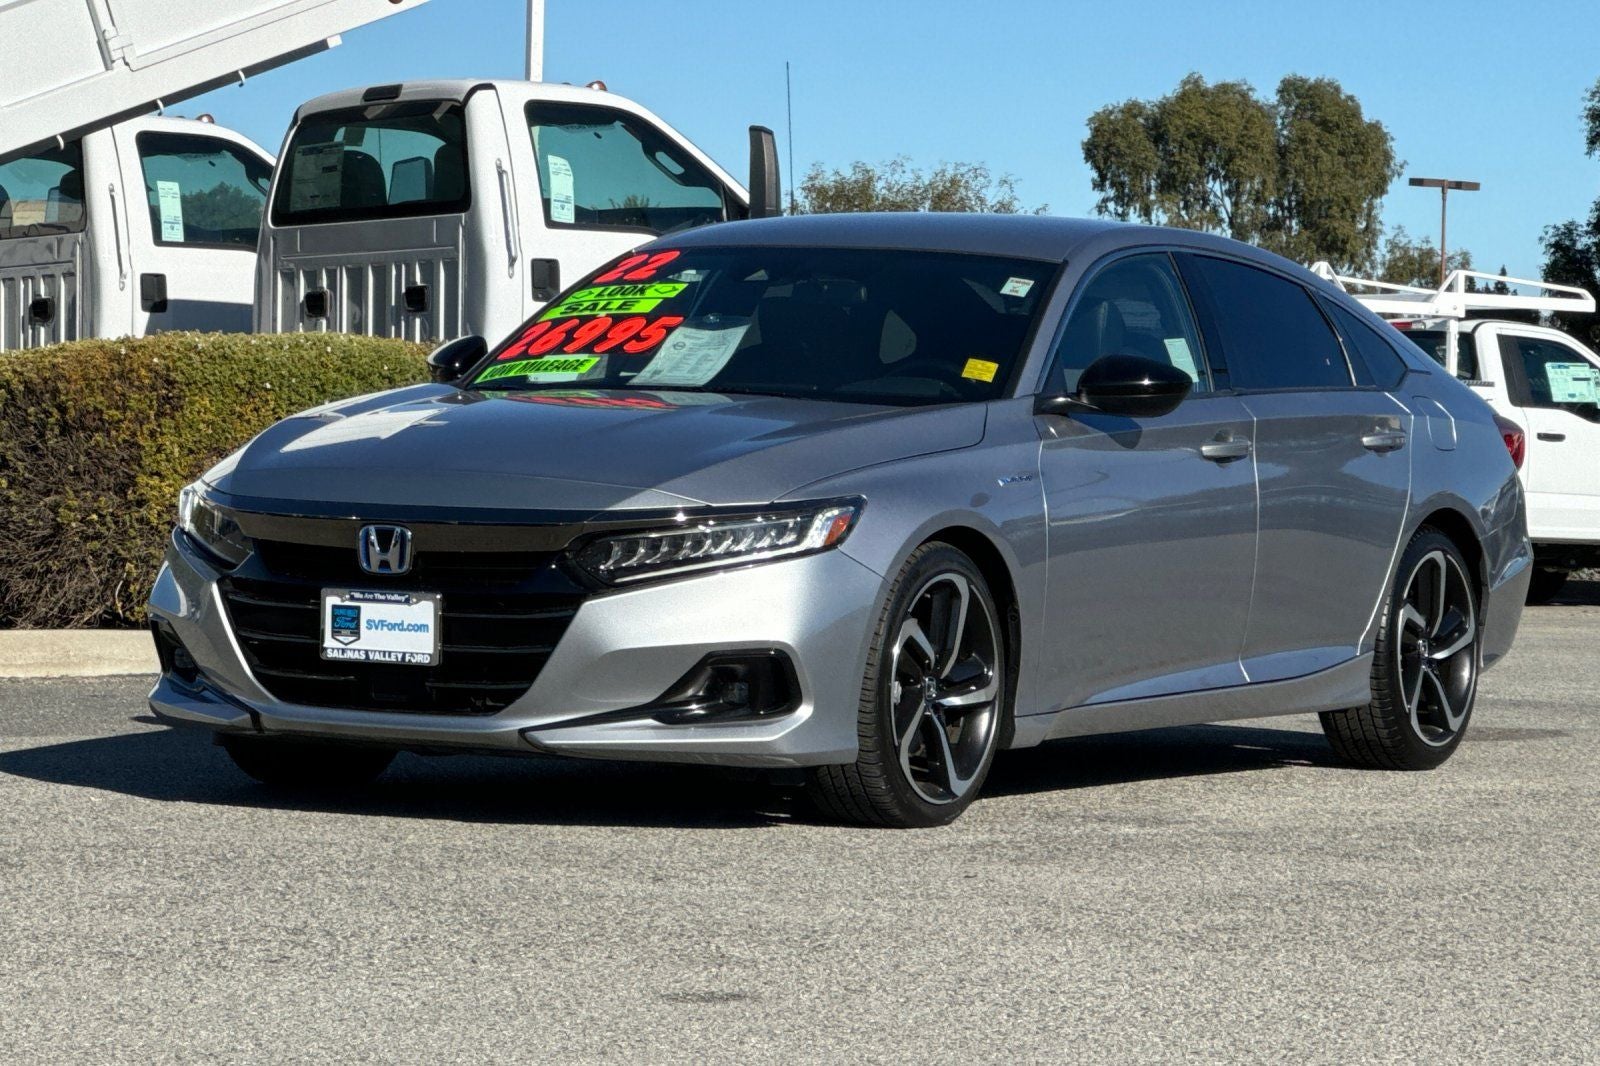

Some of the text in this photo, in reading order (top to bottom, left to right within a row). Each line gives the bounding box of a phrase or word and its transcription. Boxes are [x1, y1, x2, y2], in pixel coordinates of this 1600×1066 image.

[592, 250, 682, 284] 22
[595, 284, 650, 298] LOOK
[562, 299, 638, 314] SALE
[497, 316, 685, 360] 26995
[484, 359, 589, 378] LOW MILEAGE
[365, 619, 429, 633] SVFord.com
[326, 648, 431, 664] SALINAS VALLEY FORD
